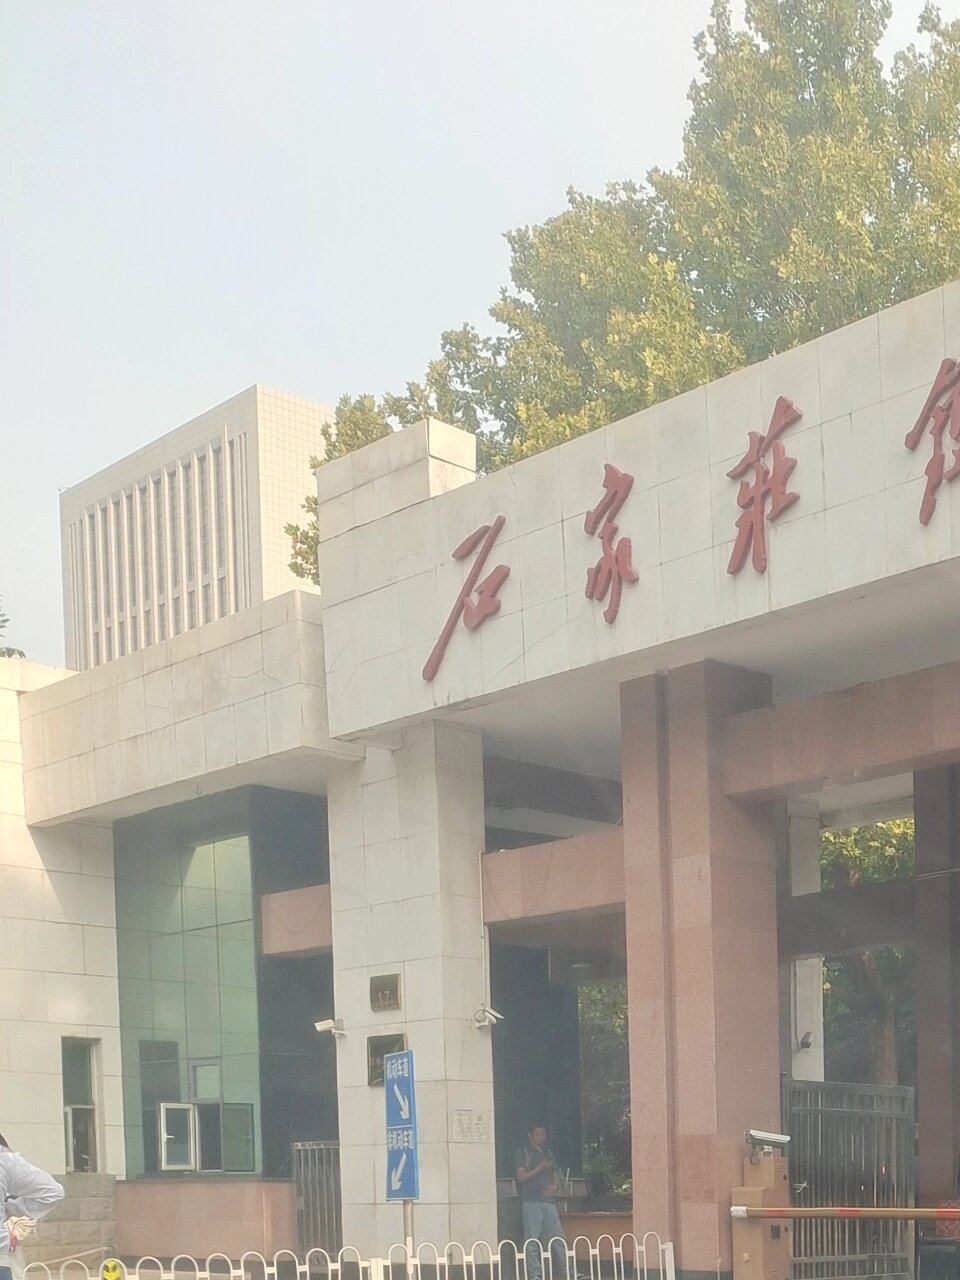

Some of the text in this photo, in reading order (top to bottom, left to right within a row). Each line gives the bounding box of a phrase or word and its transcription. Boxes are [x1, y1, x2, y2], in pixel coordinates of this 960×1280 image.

[386, 1057, 409, 1079] 机动车道
[386, 1129, 414, 1151] 非机动车道
